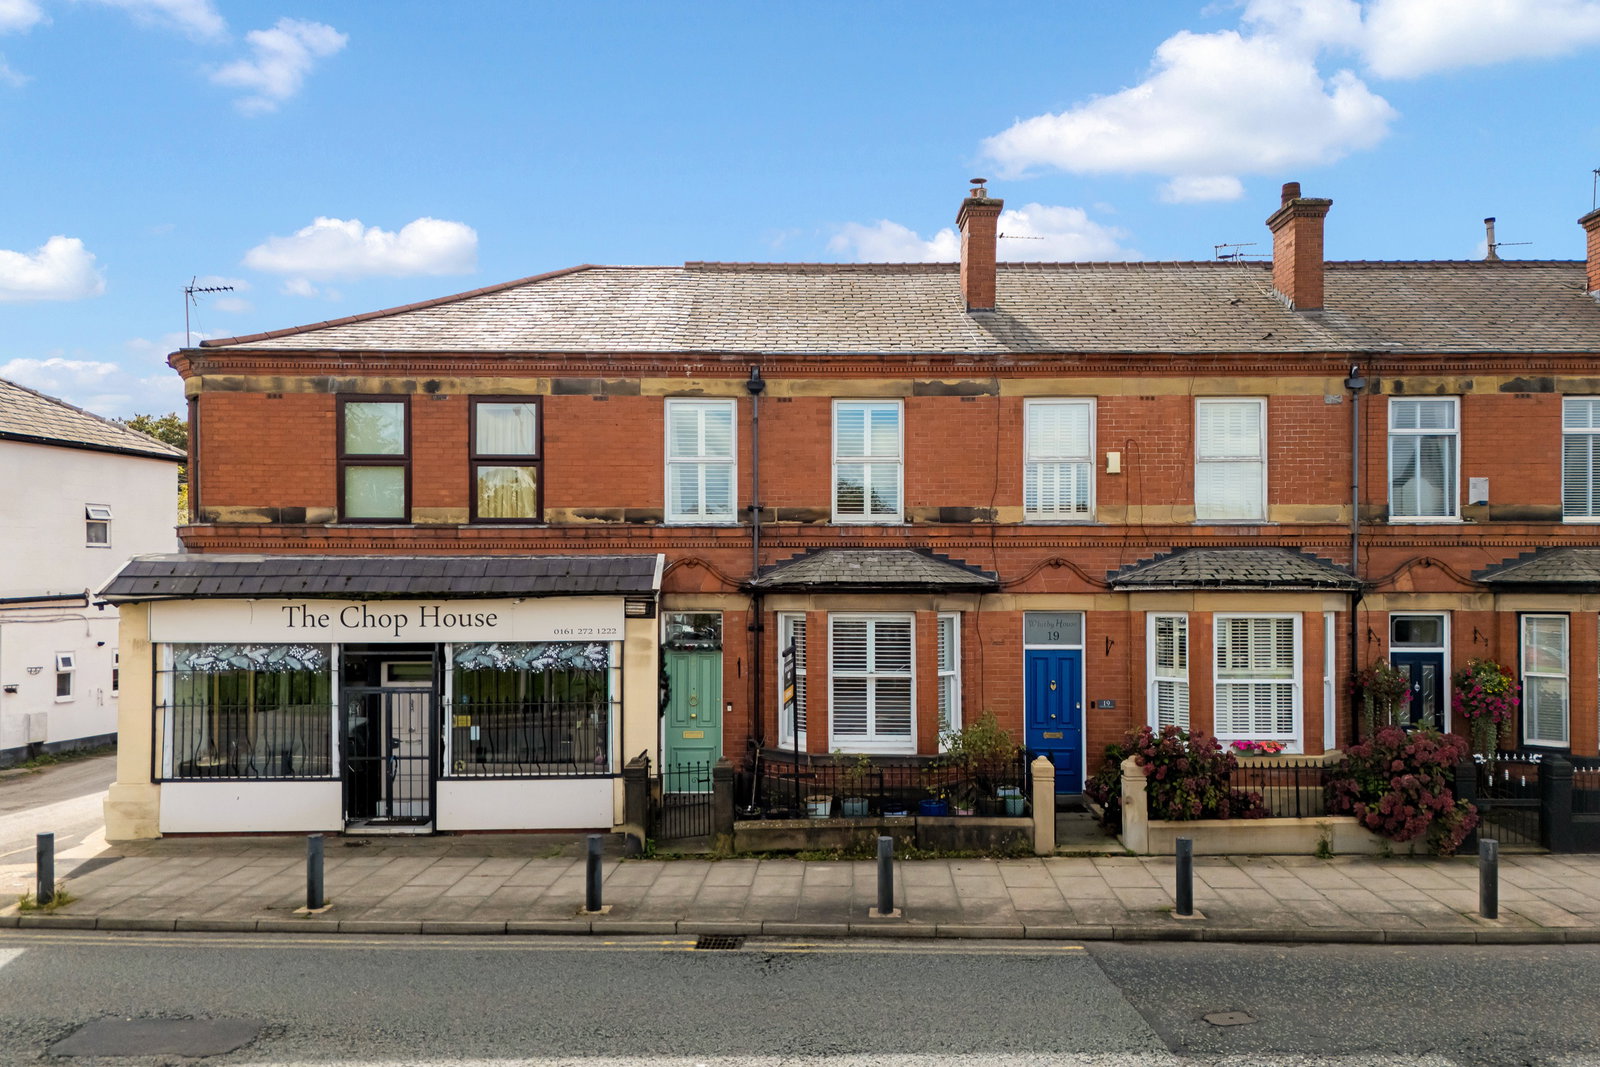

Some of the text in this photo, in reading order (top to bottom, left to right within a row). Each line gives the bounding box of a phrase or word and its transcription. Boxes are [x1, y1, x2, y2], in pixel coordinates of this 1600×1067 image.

[282, 603, 498, 637] The Chop House
[1047, 631, 1060, 641] 19
